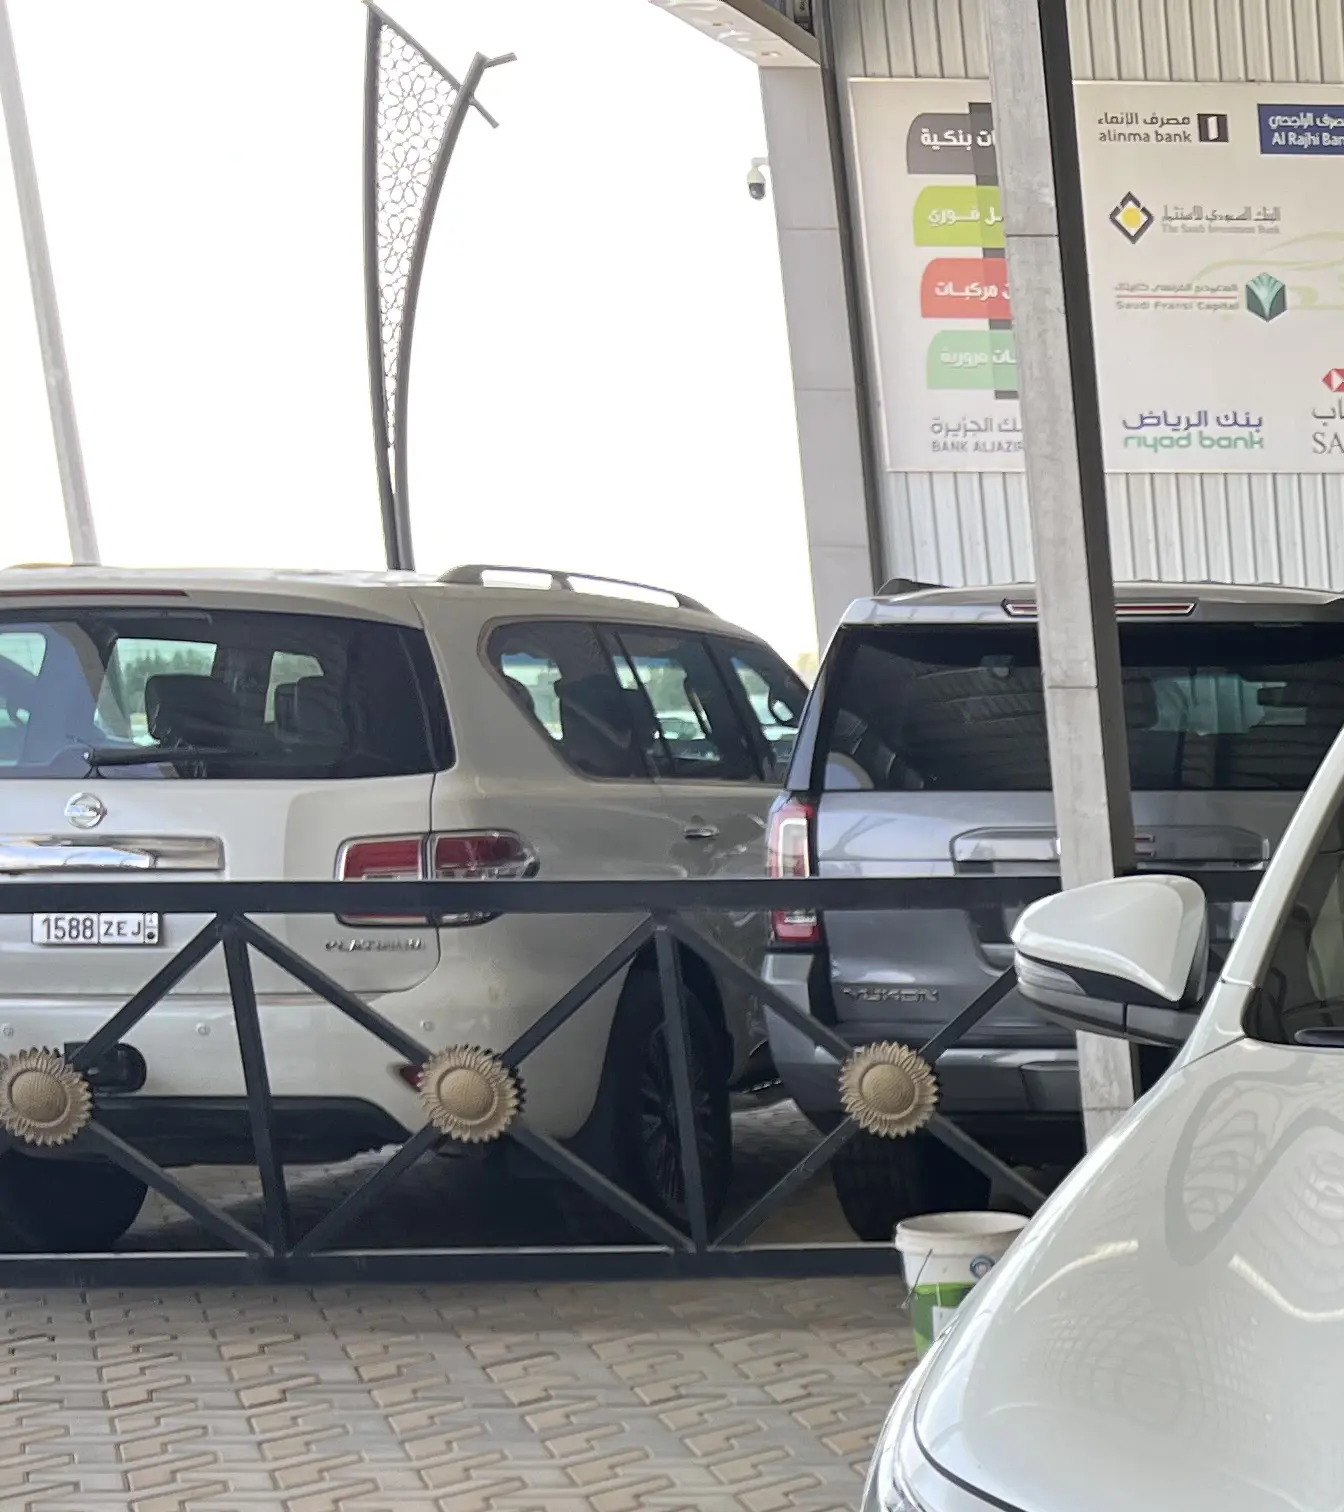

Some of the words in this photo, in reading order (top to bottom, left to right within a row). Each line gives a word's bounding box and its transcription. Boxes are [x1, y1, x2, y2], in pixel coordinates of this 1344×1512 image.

[1143, 112, 1191, 128] مصرف
[1099, 129, 1150, 143] alinma
[1154, 130, 1192, 143] bank
[1271, 131, 1286, 146] Al
[1288, 131, 1320, 149] Rajhi
[930, 416, 994, 438] الجزيرة
[1122, 410, 1208, 432] الرياض
[1216, 411, 1263, 433] بنك
[931, 440, 968, 453] BANK
[973, 440, 1024, 454] ALJAZIR
[1123, 431, 1193, 453] riyad
[1198, 430, 1264, 449] bank
[42, 916, 95, 941] 1588
[103, 919, 142, 937] ZEJ
